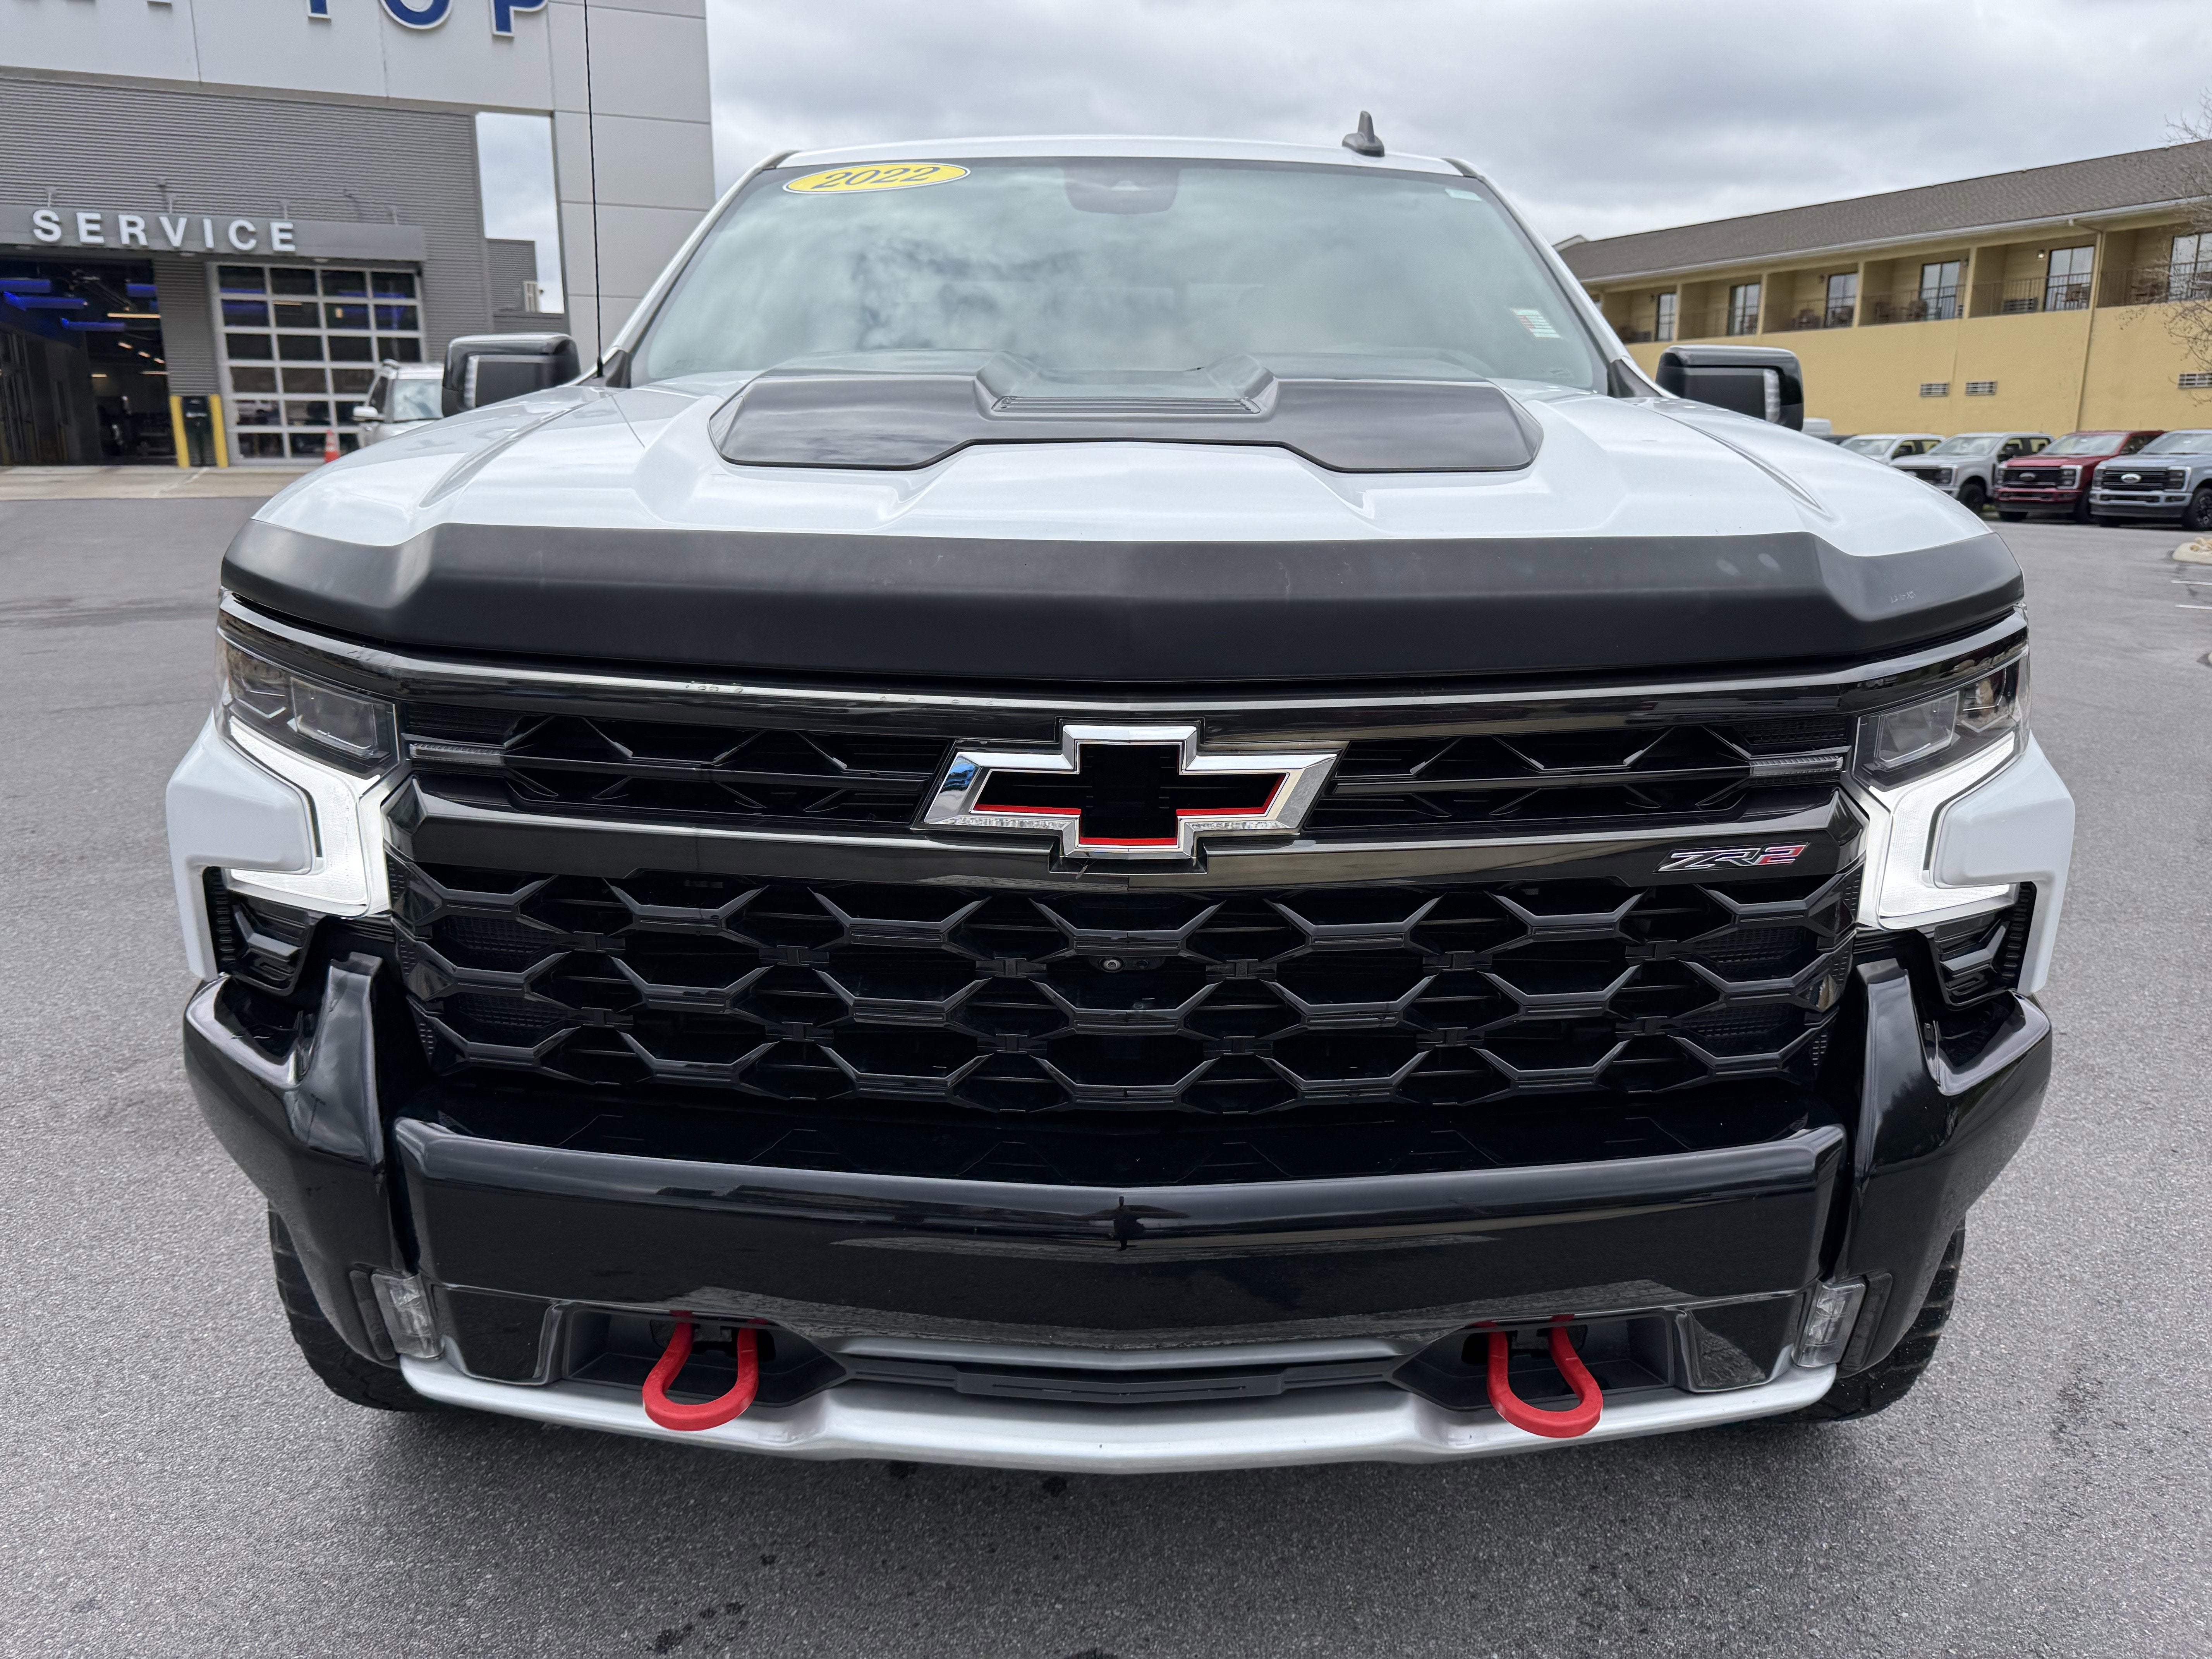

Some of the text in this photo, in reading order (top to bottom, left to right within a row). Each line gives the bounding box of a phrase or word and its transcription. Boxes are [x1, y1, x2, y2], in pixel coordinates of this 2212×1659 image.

[811, 167, 940, 189] 2022
[33, 210, 296, 252] SERVICE
[1658, 844, 1807, 872] ZR2
